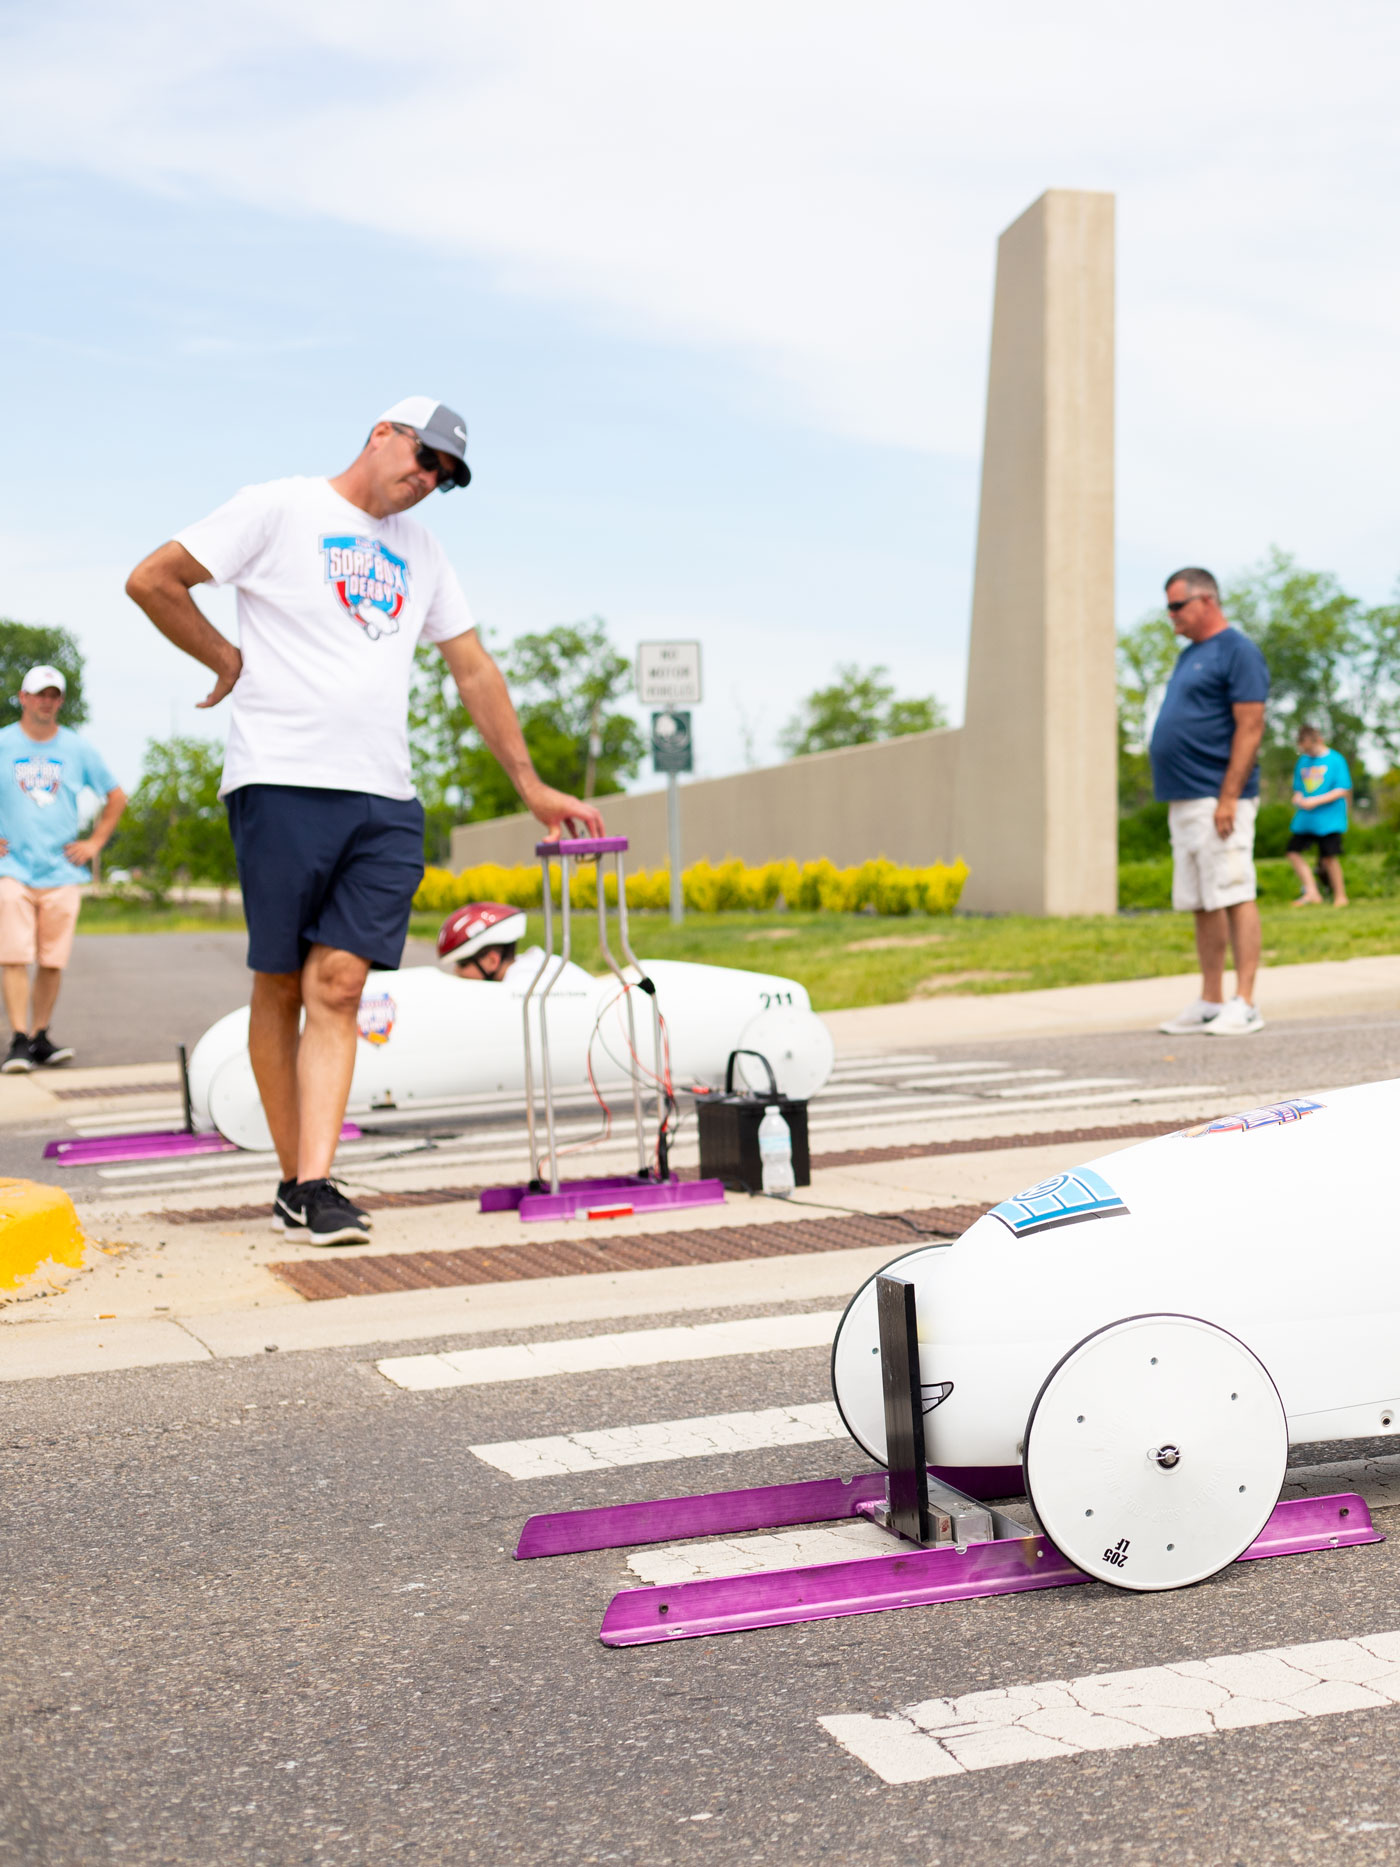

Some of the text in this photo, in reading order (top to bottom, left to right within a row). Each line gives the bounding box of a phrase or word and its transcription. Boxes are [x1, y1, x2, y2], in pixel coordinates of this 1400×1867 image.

[329, 546, 406, 597] SOAP BOX
[350, 575, 392, 604] DERBY
[1114, 1538, 1130, 1553] LF
[1102, 1548, 1129, 1568] 205
